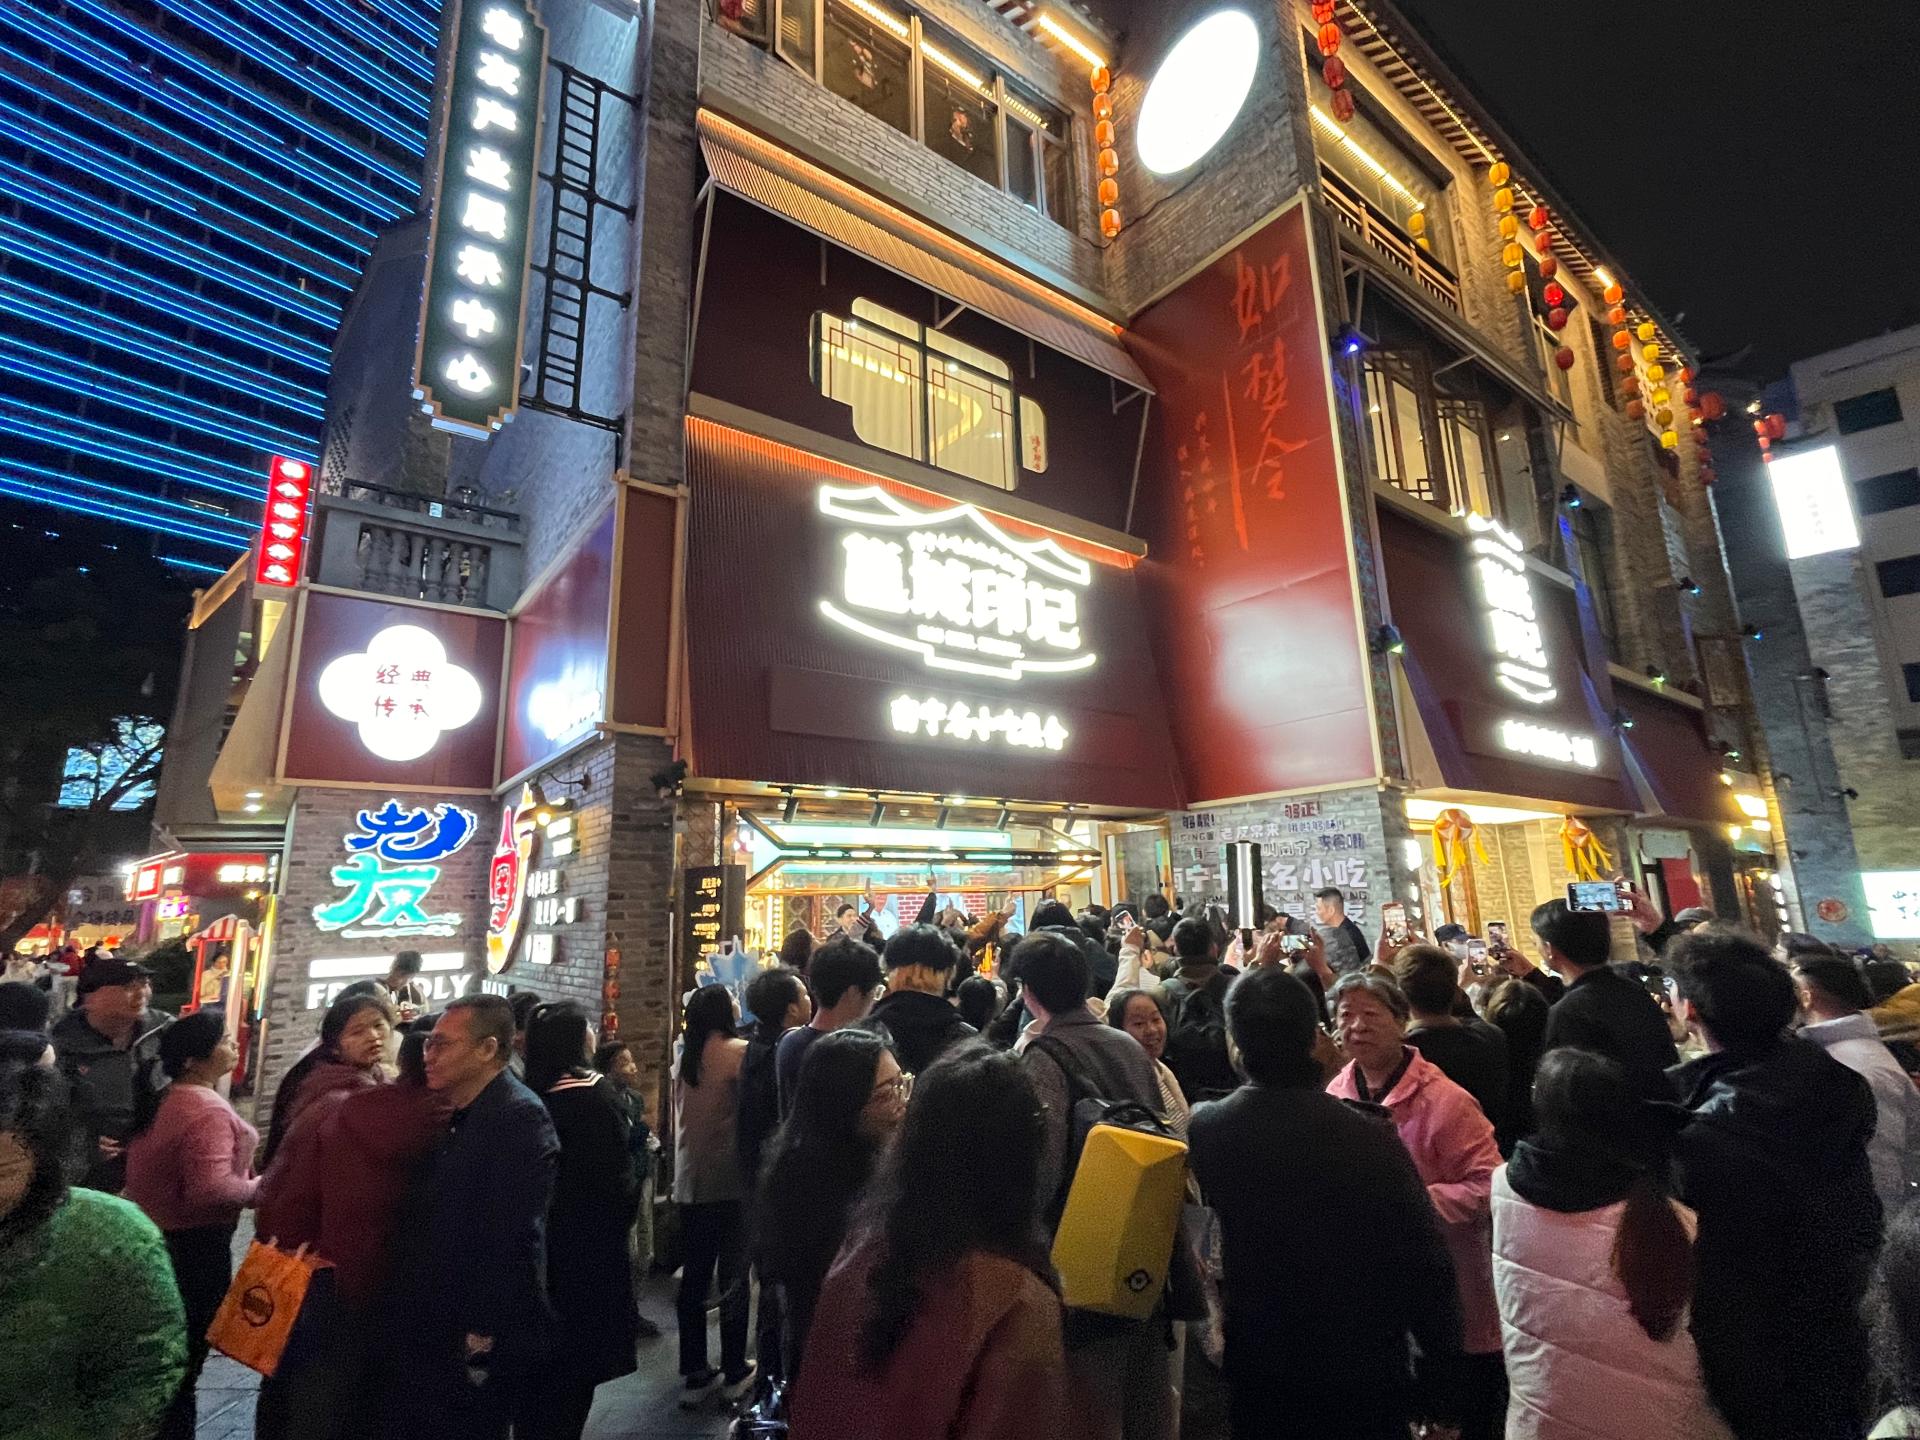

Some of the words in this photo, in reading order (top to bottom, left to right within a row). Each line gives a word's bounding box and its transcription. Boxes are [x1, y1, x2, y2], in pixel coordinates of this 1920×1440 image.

[375, 664, 432, 690] 经典
[374, 695, 430, 720] 传承
[312, 799, 478, 938] 老友
